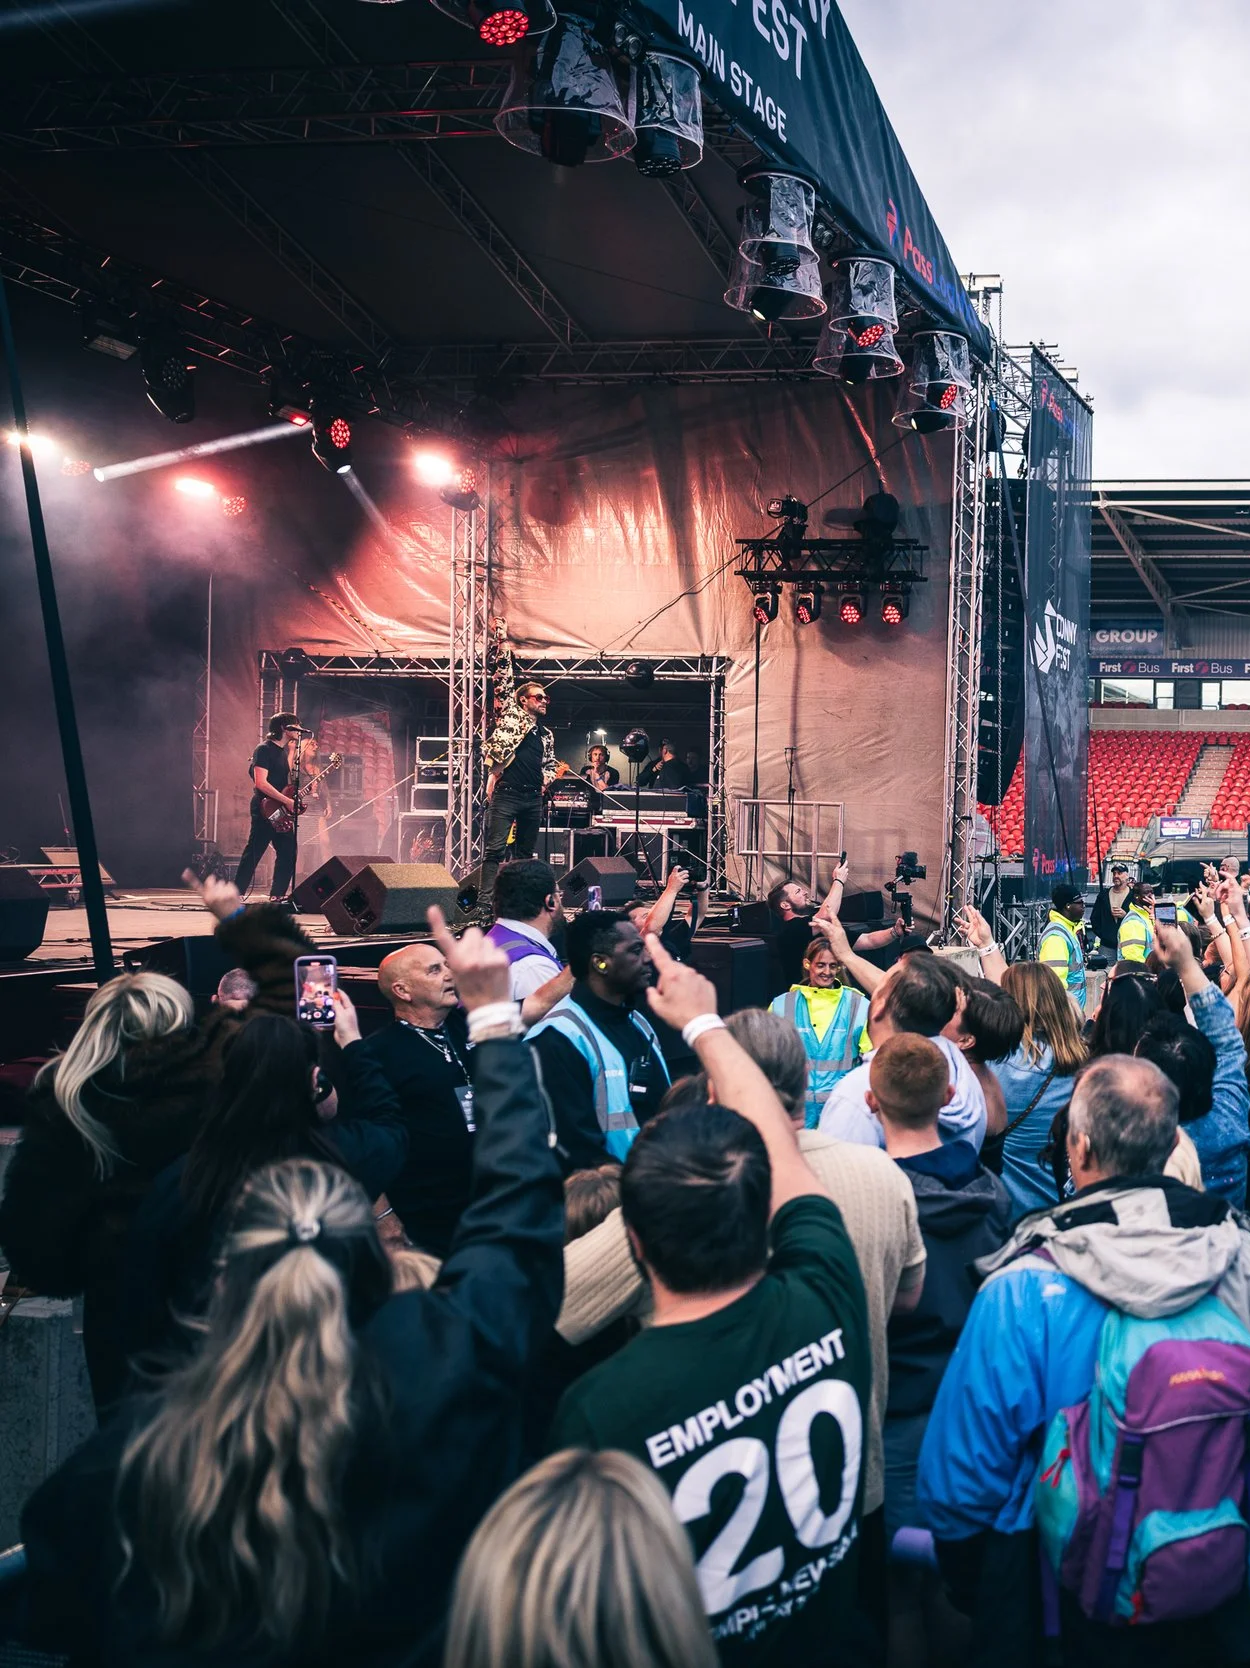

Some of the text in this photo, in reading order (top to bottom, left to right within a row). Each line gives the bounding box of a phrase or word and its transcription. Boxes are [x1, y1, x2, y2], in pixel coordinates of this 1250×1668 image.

[678, 1, 787, 143] MAIN STAGE
[731, 0, 807, 80] EST
[903, 225, 934, 285] Pass
[1095, 629, 1158, 643] GROUP
[1100, 662, 1159, 673] First Bus
[1172, 663, 1232, 673] First Bus
[645, 1327, 847, 1469] EMPLOYMENT
[671, 1378, 863, 1616] 20
